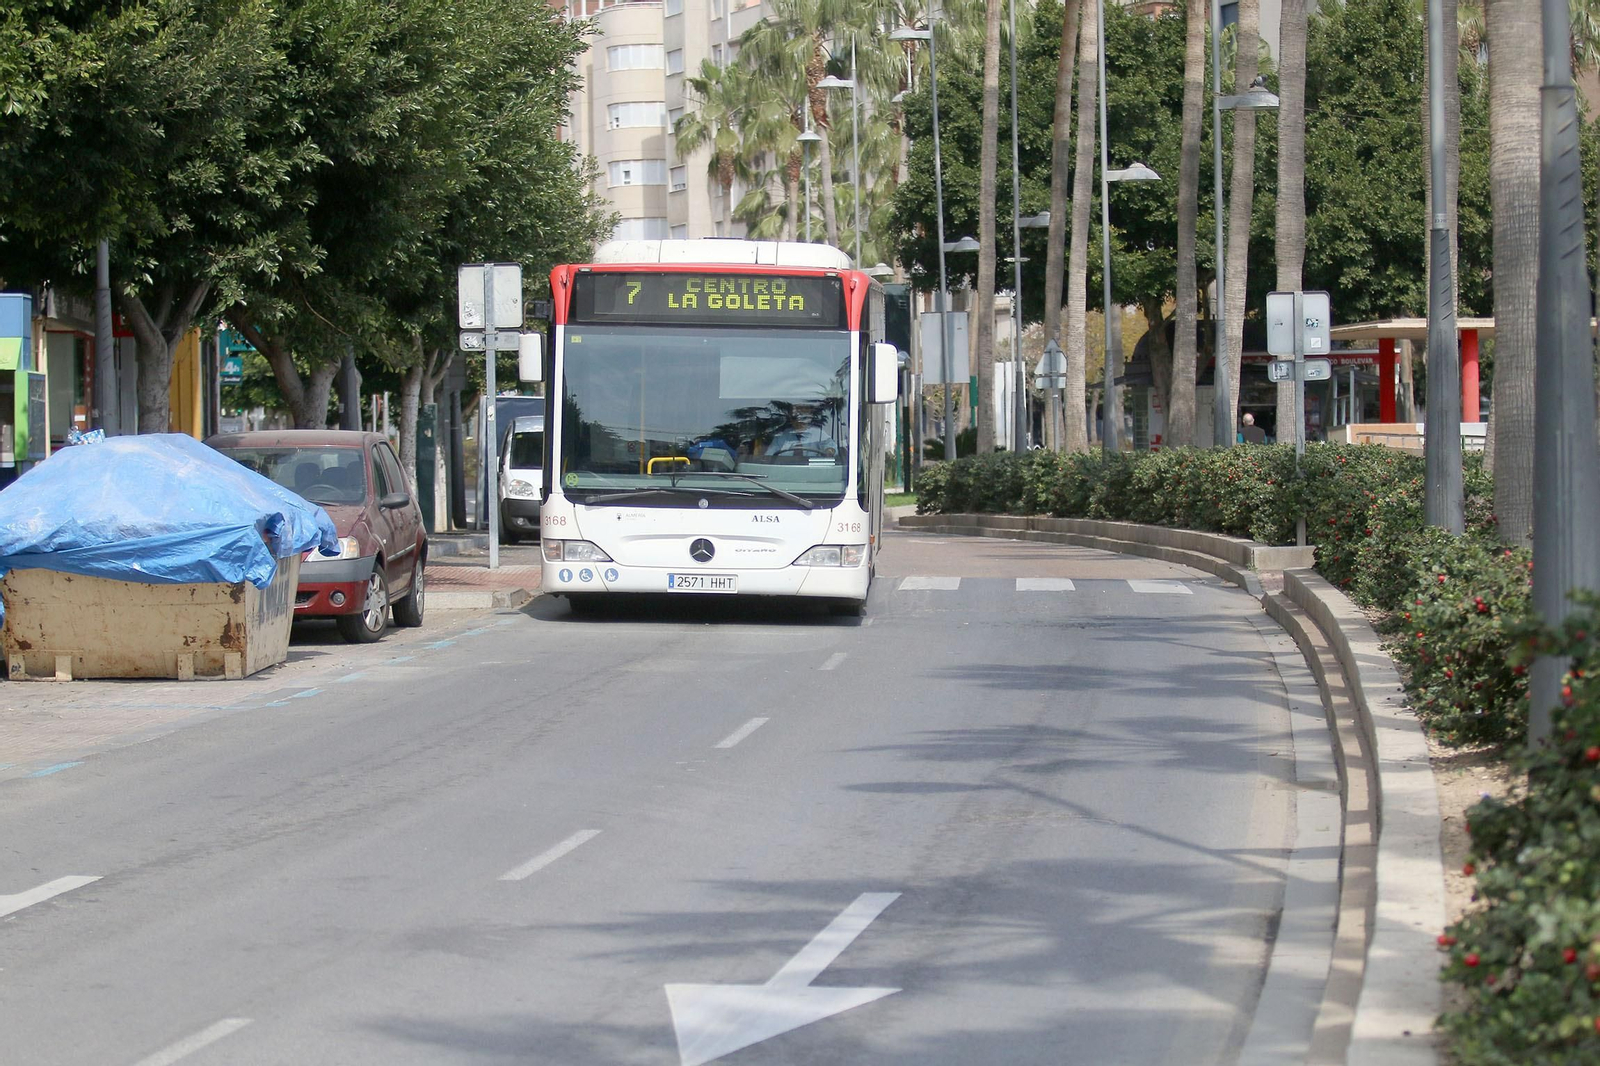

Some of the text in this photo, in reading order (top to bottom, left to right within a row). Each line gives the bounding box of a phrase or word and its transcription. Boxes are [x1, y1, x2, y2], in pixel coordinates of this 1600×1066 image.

[686, 277, 787, 294] CENTRO
[626, 281, 642, 305] 7
[668, 293, 804, 311] LA GOLETA
[544, 515, 567, 527] 3168
[751, 514, 781, 523] ALSA
[837, 522, 862, 533] 3168
[677, 576, 733, 589] 2571 HHT
